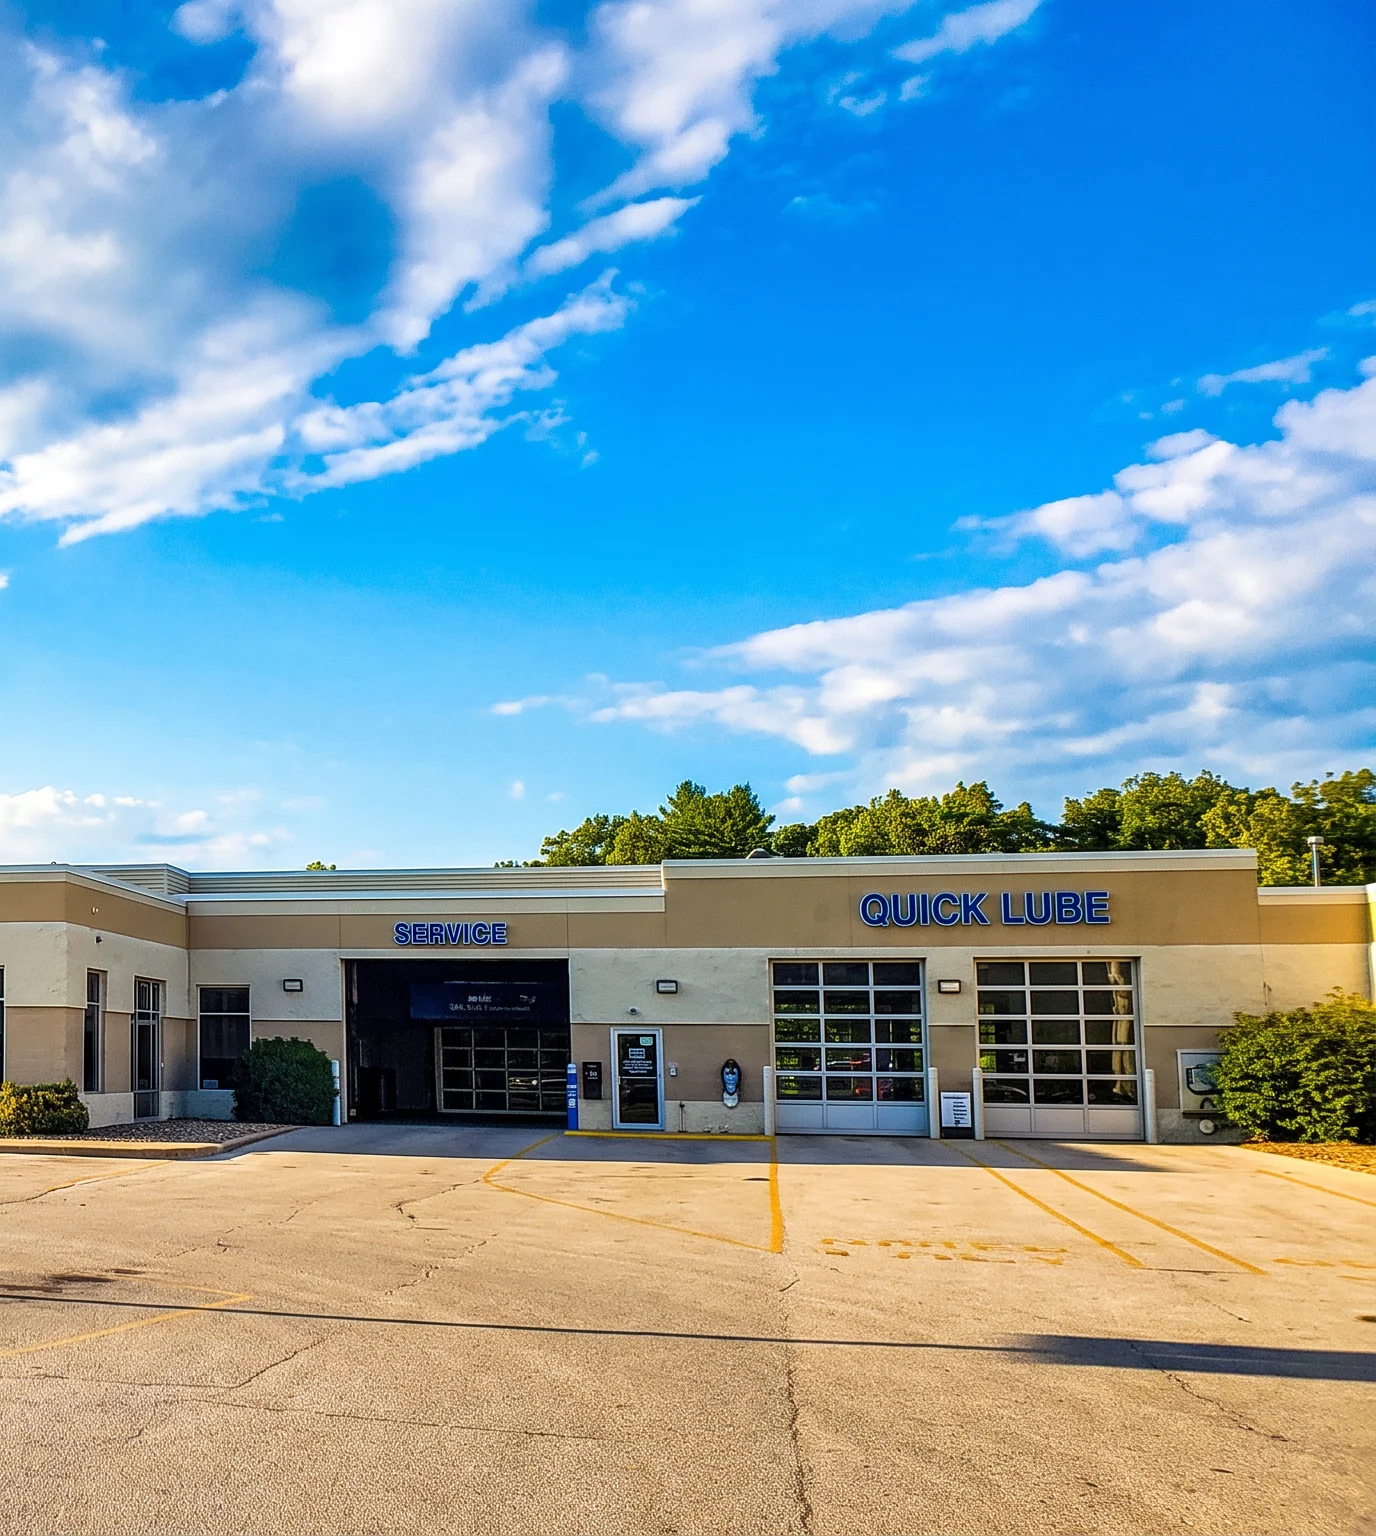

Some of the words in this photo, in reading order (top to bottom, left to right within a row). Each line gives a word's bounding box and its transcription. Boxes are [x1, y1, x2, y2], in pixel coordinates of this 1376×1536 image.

[859, 891, 991, 928] QUICK
[1000, 889, 1111, 926] LUBE
[393, 921, 508, 946] SERVICE
